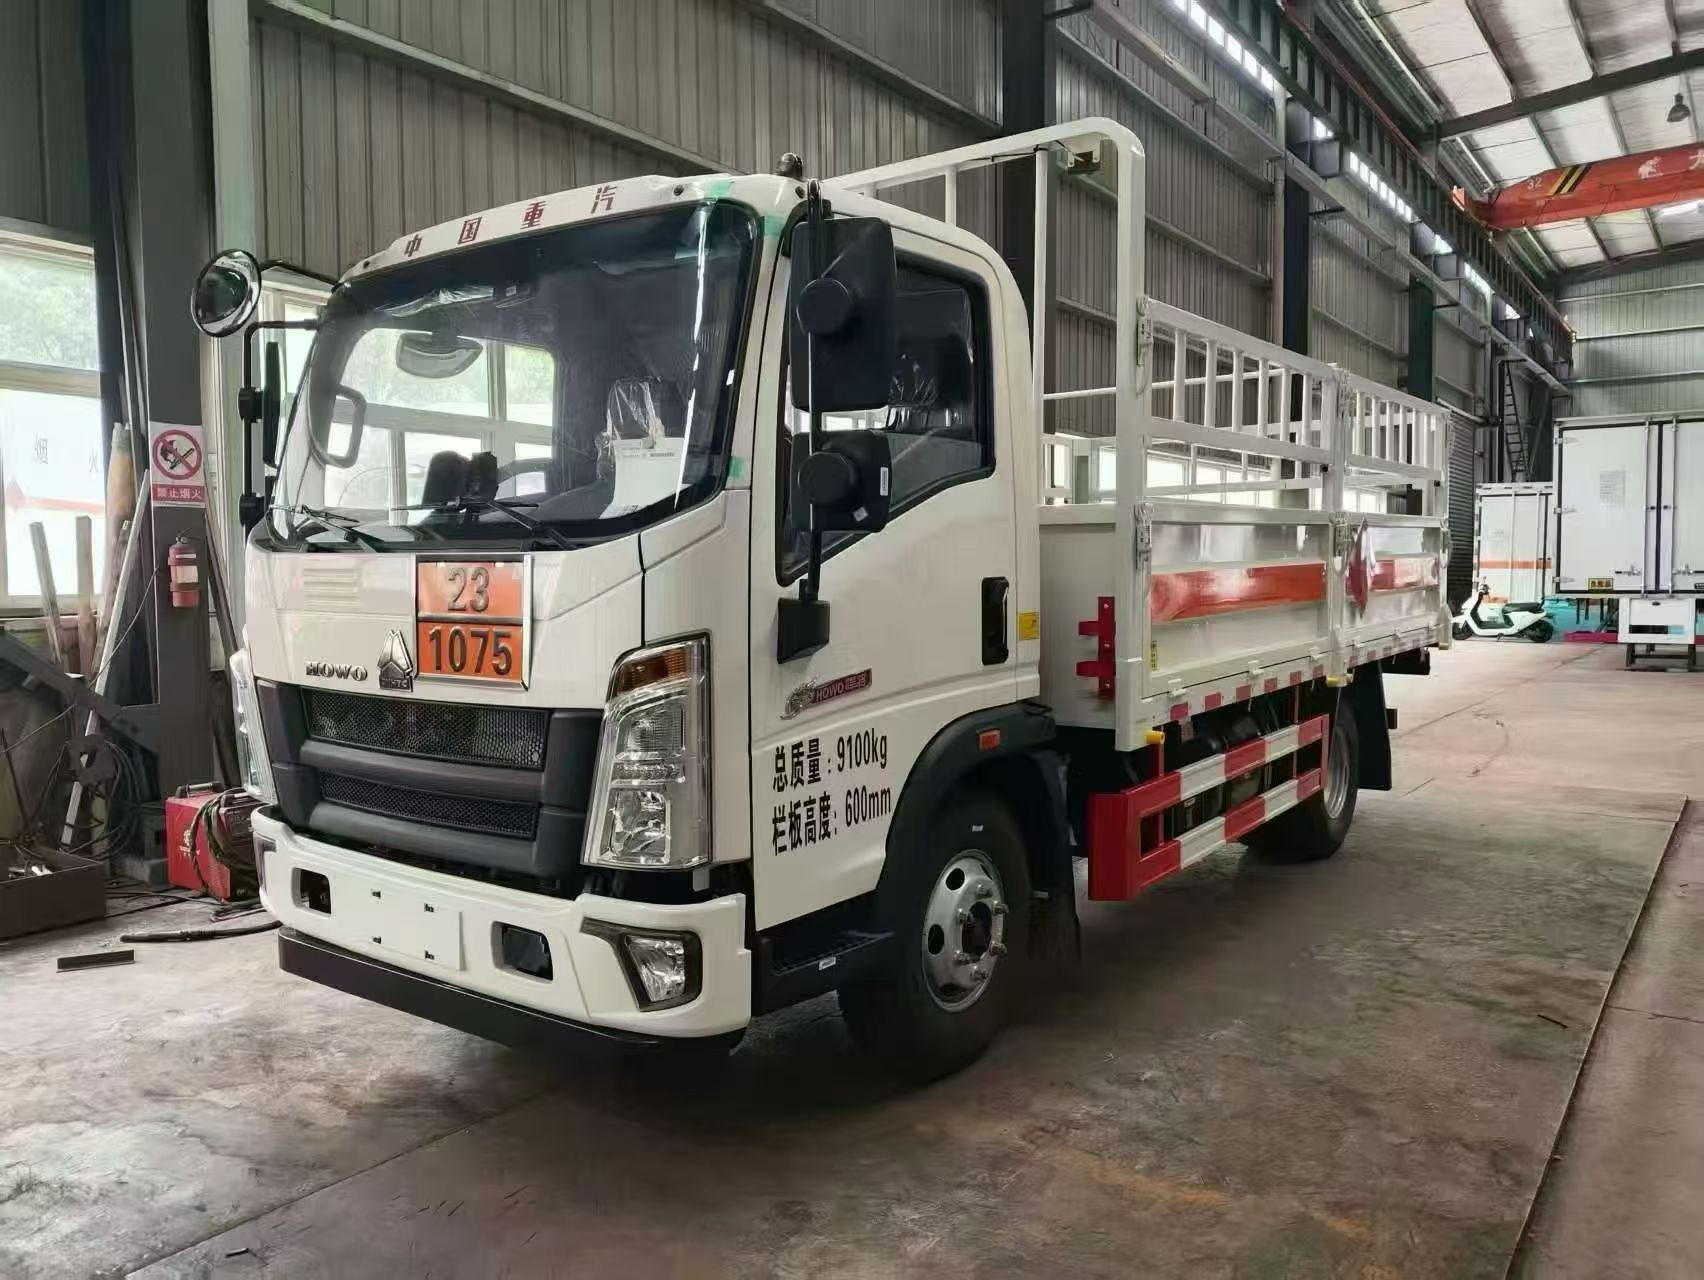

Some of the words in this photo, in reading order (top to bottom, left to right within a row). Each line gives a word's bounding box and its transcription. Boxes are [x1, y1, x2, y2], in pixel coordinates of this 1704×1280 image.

[404, 185, 618, 257] 中国重汽
[448, 567, 490, 612] 23
[305, 661, 369, 681] HOWO
[428, 626, 513, 676] 1075
[815, 681, 844, 702] HOWO
